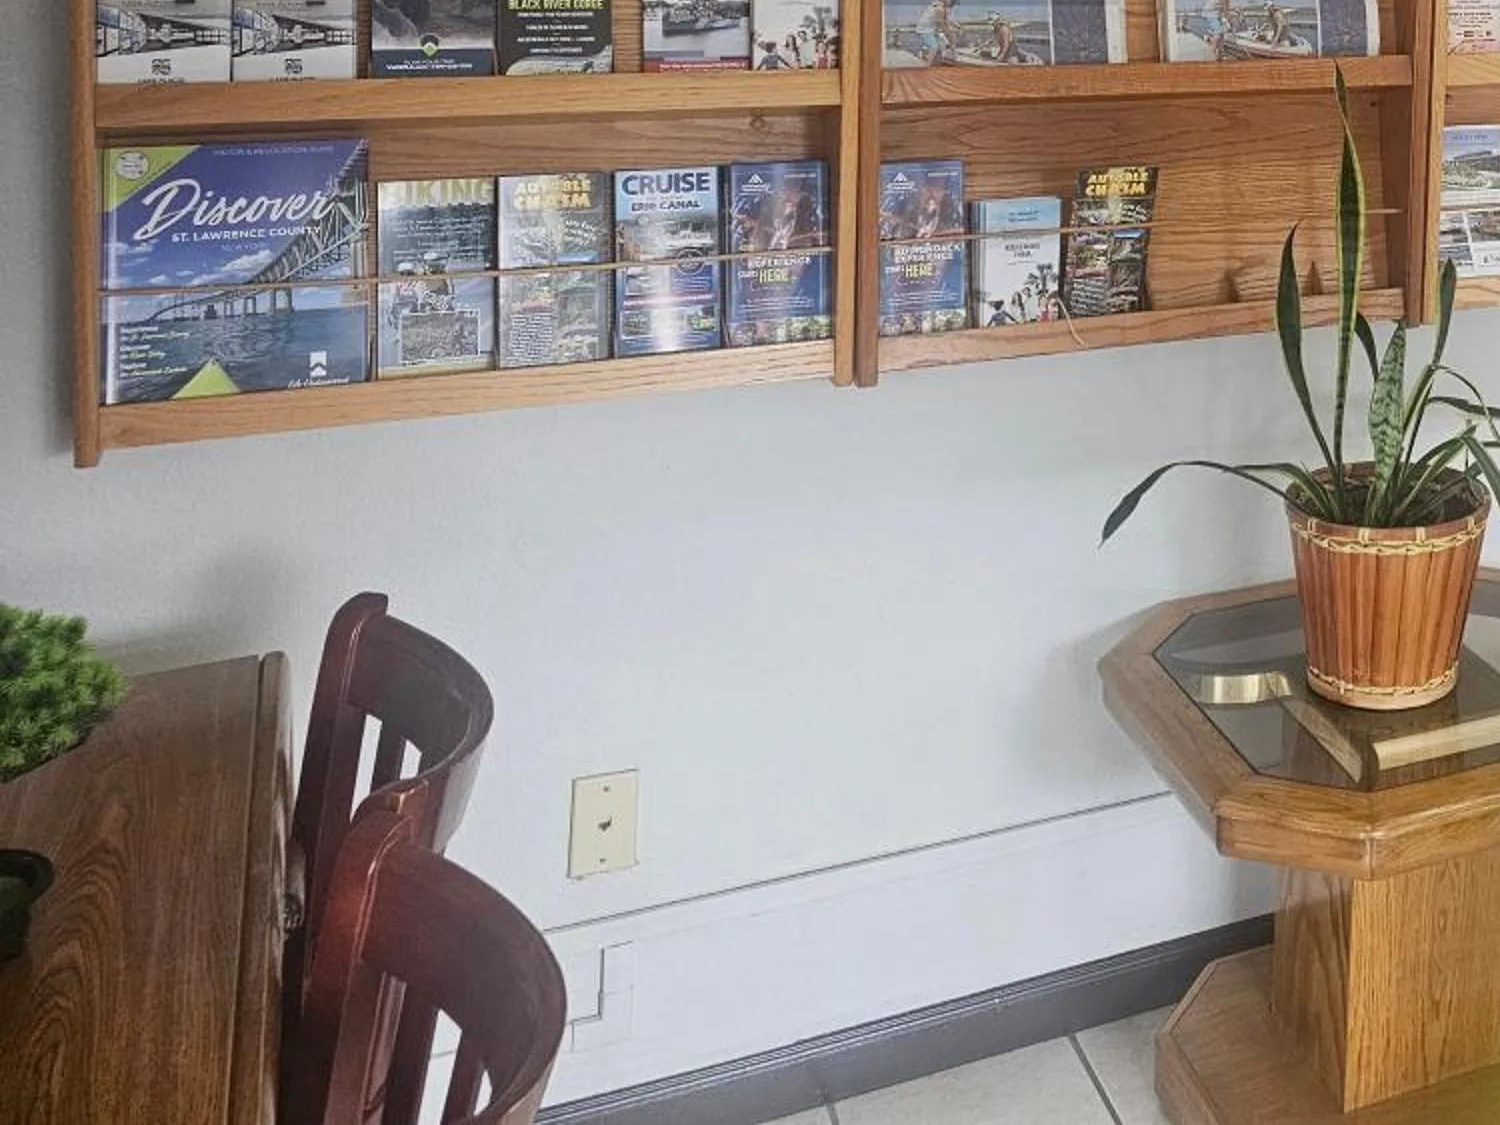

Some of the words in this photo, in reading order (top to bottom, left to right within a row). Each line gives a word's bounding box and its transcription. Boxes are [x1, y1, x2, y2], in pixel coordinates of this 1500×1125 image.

[622, 172, 711, 196] CRUISE
[133, 177, 335, 242] Discover
[660, 199, 702, 210] CANAL
[172, 233, 190, 243] ST.
[193, 229, 266, 241] LAWRENCE
[270, 225, 321, 237] COUNTY
[759, 269, 790, 284] HERE
[905, 263, 933, 278] HERE
